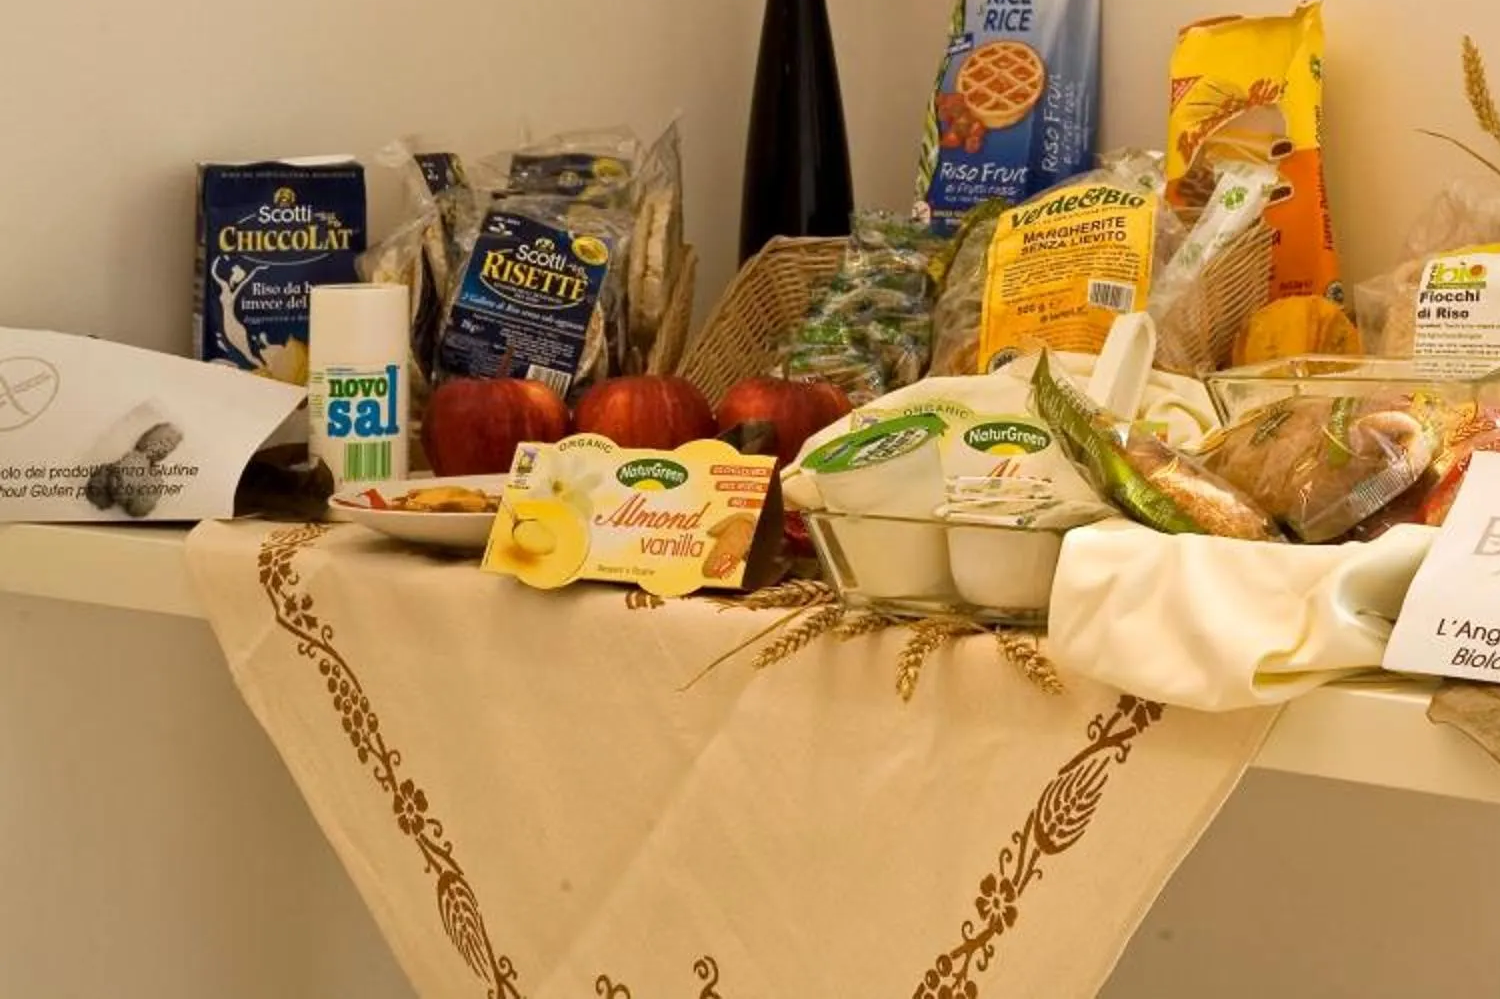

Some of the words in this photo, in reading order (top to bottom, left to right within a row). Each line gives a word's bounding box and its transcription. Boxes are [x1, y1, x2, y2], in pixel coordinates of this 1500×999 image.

[983, 8, 1033, 32] RICE
[1041, 128, 1061, 173] Riso
[940, 162, 979, 182] Riso
[257, 205, 313, 225] Scotti
[1022, 216, 1127, 244] MARGHERITE
[1021, 239, 1066, 256] SENZA
[1070, 230, 1127, 247] LIEVITO
[515, 243, 568, 271] Scotti
[482, 250, 589, 301] RISETTE
[252, 282, 281, 296] Riso
[283, 281, 302, 295] da
[1418, 290, 1481, 303] Fiocchi
[240, 298, 284, 310] invece
[1417, 306, 1432, 319] di
[1435, 306, 1469, 319] Riso
[328, 377, 388, 398] novo
[327, 364, 400, 437] sal
[559, 435, 614, 454] ORGANIC
[968, 425, 1048, 448] NaturGreen
[0, 464, 21, 479] olo
[25, 464, 46, 478] dei
[619, 460, 686, 484] NaturGreen
[30, 484, 73, 498] Gluten
[594, 494, 712, 531] Almond
[640, 533, 704, 558] vanilla
